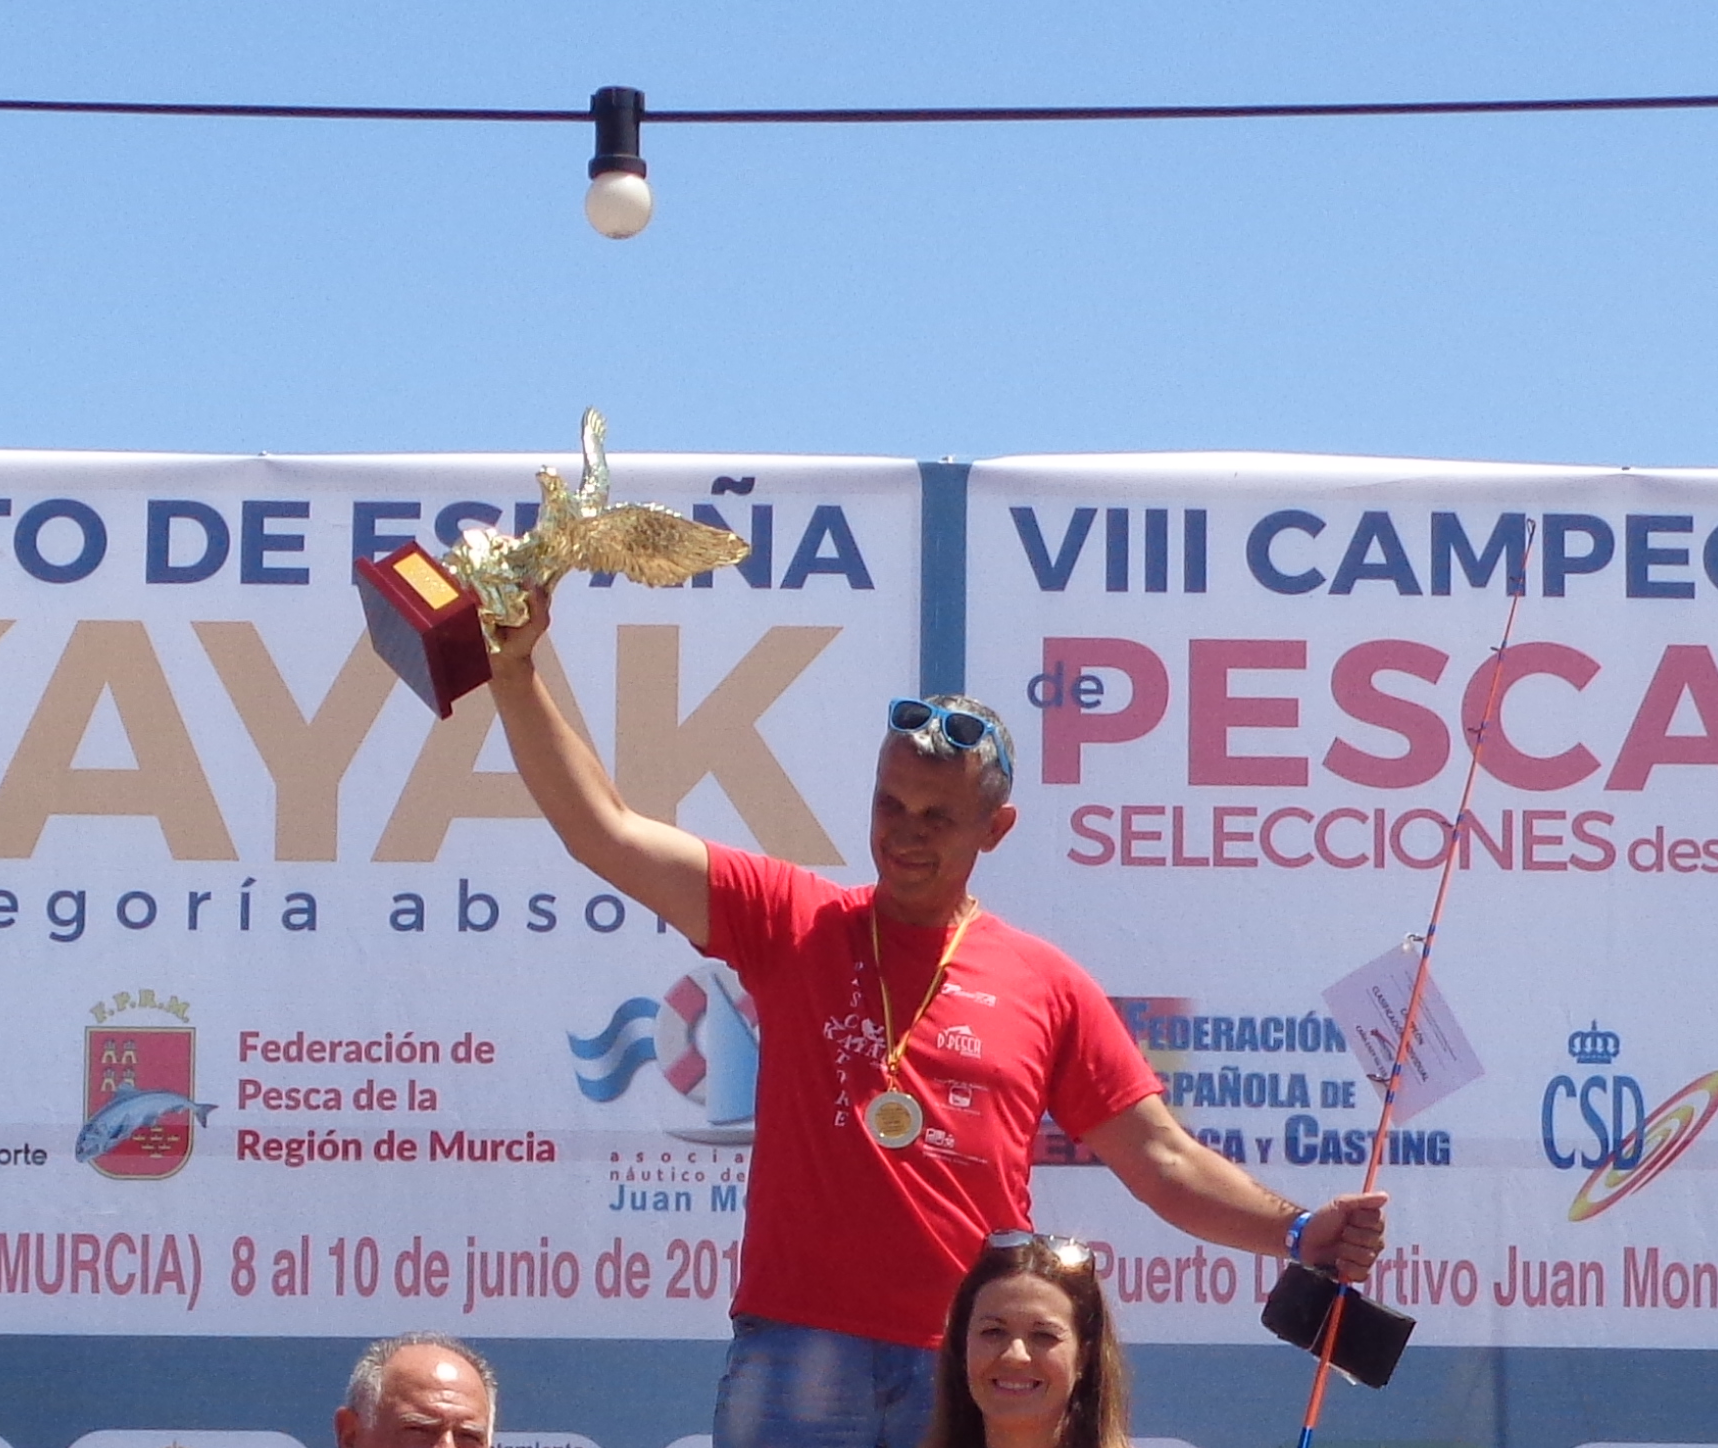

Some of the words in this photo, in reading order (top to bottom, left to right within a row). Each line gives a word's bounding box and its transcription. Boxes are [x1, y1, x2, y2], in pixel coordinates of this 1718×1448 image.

[147, 500, 309, 585] DE
[1009, 507, 1207, 593] VIII
[1027, 662, 1104, 710] de
[1068, 805, 1617, 874] SELECCIONES
[239, 1032, 439, 1065] Federación
[450, 1033, 495, 1065] de
[238, 1080, 342, 1111] Pesca
[352, 1079, 397, 1111] de
[408, 1079, 437, 1111] la
[1319, 1079, 1355, 1109] DE
[1541, 1074, 1645, 1171] CSD
[237, 1130, 366, 1167] Región
[378, 1130, 420, 1162] de
[429, 1130, 556, 1163] Murcia
[609, 1167, 704, 1183] náutico
[609, 1185, 692, 1213] Juan
[231, 1236, 256, 1297] 8
[272, 1234, 311, 1297] al
[328, 1237, 379, 1298] 10
[394, 1235, 450, 1298] de
[462, 1235, 580, 1314] junio
[595, 1237, 651, 1299] de
[1494, 1246, 1605, 1308] Juan
